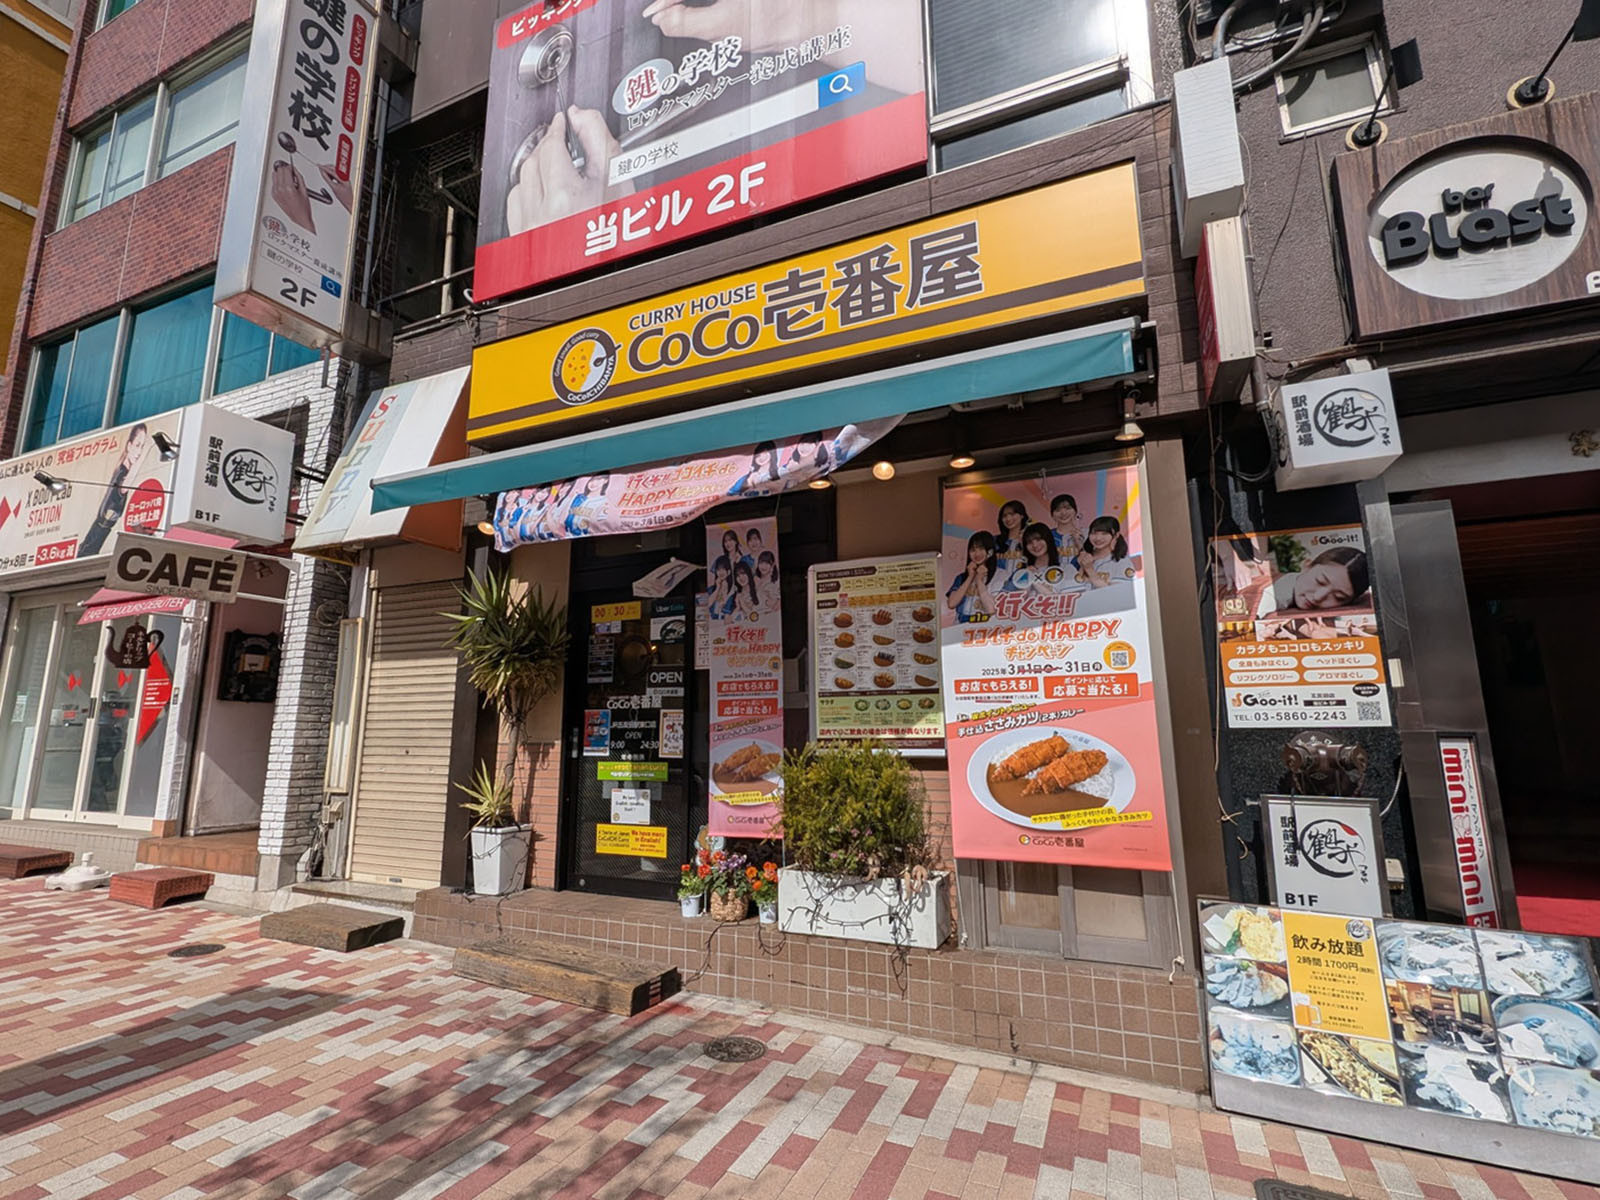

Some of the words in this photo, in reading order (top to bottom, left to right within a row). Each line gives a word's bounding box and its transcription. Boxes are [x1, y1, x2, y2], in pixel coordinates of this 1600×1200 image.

[624, 36, 743, 110] 鍵の学校
[626, 25, 853, 132] ロックマスター養成講座
[616, 140, 680, 176] 鍵の学校
[583, 190, 694, 258] 当ビル
[706, 161, 767, 216] 2F
[1441, 182, 1495, 217] bar
[1383, 192, 1576, 271] Blast
[280, 277, 318, 308] 2F
[627, 220, 985, 374] CoCo壱番屋
[628, 301, 687, 332] CURRY
[690, 283, 757, 316] HOUSE
[1290, 394, 1315, 448] 駅前酒場
[56, 436, 118, 467] 究極プログラム
[204, 435, 224, 488] 駅前酒場
[617, 486, 679, 507] HAPPY
[27, 503, 63, 528] STATION
[194, 509, 221, 523] B1F
[116, 547, 238, 594] CAFÉ
[961, 626, 1016, 646] ココイチ
[1040, 618, 1121, 641] HAPPY
[1005, 643, 1074, 661] キャンペーン
[1236, 640, 1365, 656] カラダもココロもスッキリ
[1316, 656, 1361, 665] ヘッドほぐし
[649, 671, 683, 684] OPEN
[959, 678, 1033, 693] お店でもらえる!
[1236, 673, 1294, 682] リフレクソロジー
[1317, 670, 1364, 679] アロマほぐし
[1052, 684, 1129, 697] 応募で当たる!
[1242, 692, 1299, 708] Goo-it!
[1254, 710, 1348, 722] 03-5860-2243
[1442, 747, 1470, 814] mini
[1456, 836, 1485, 907] mini
[1284, 892, 1319, 908] B1F
[1290, 933, 1365, 958] 飲み放題
[1295, 955, 1322, 968] 2時間
